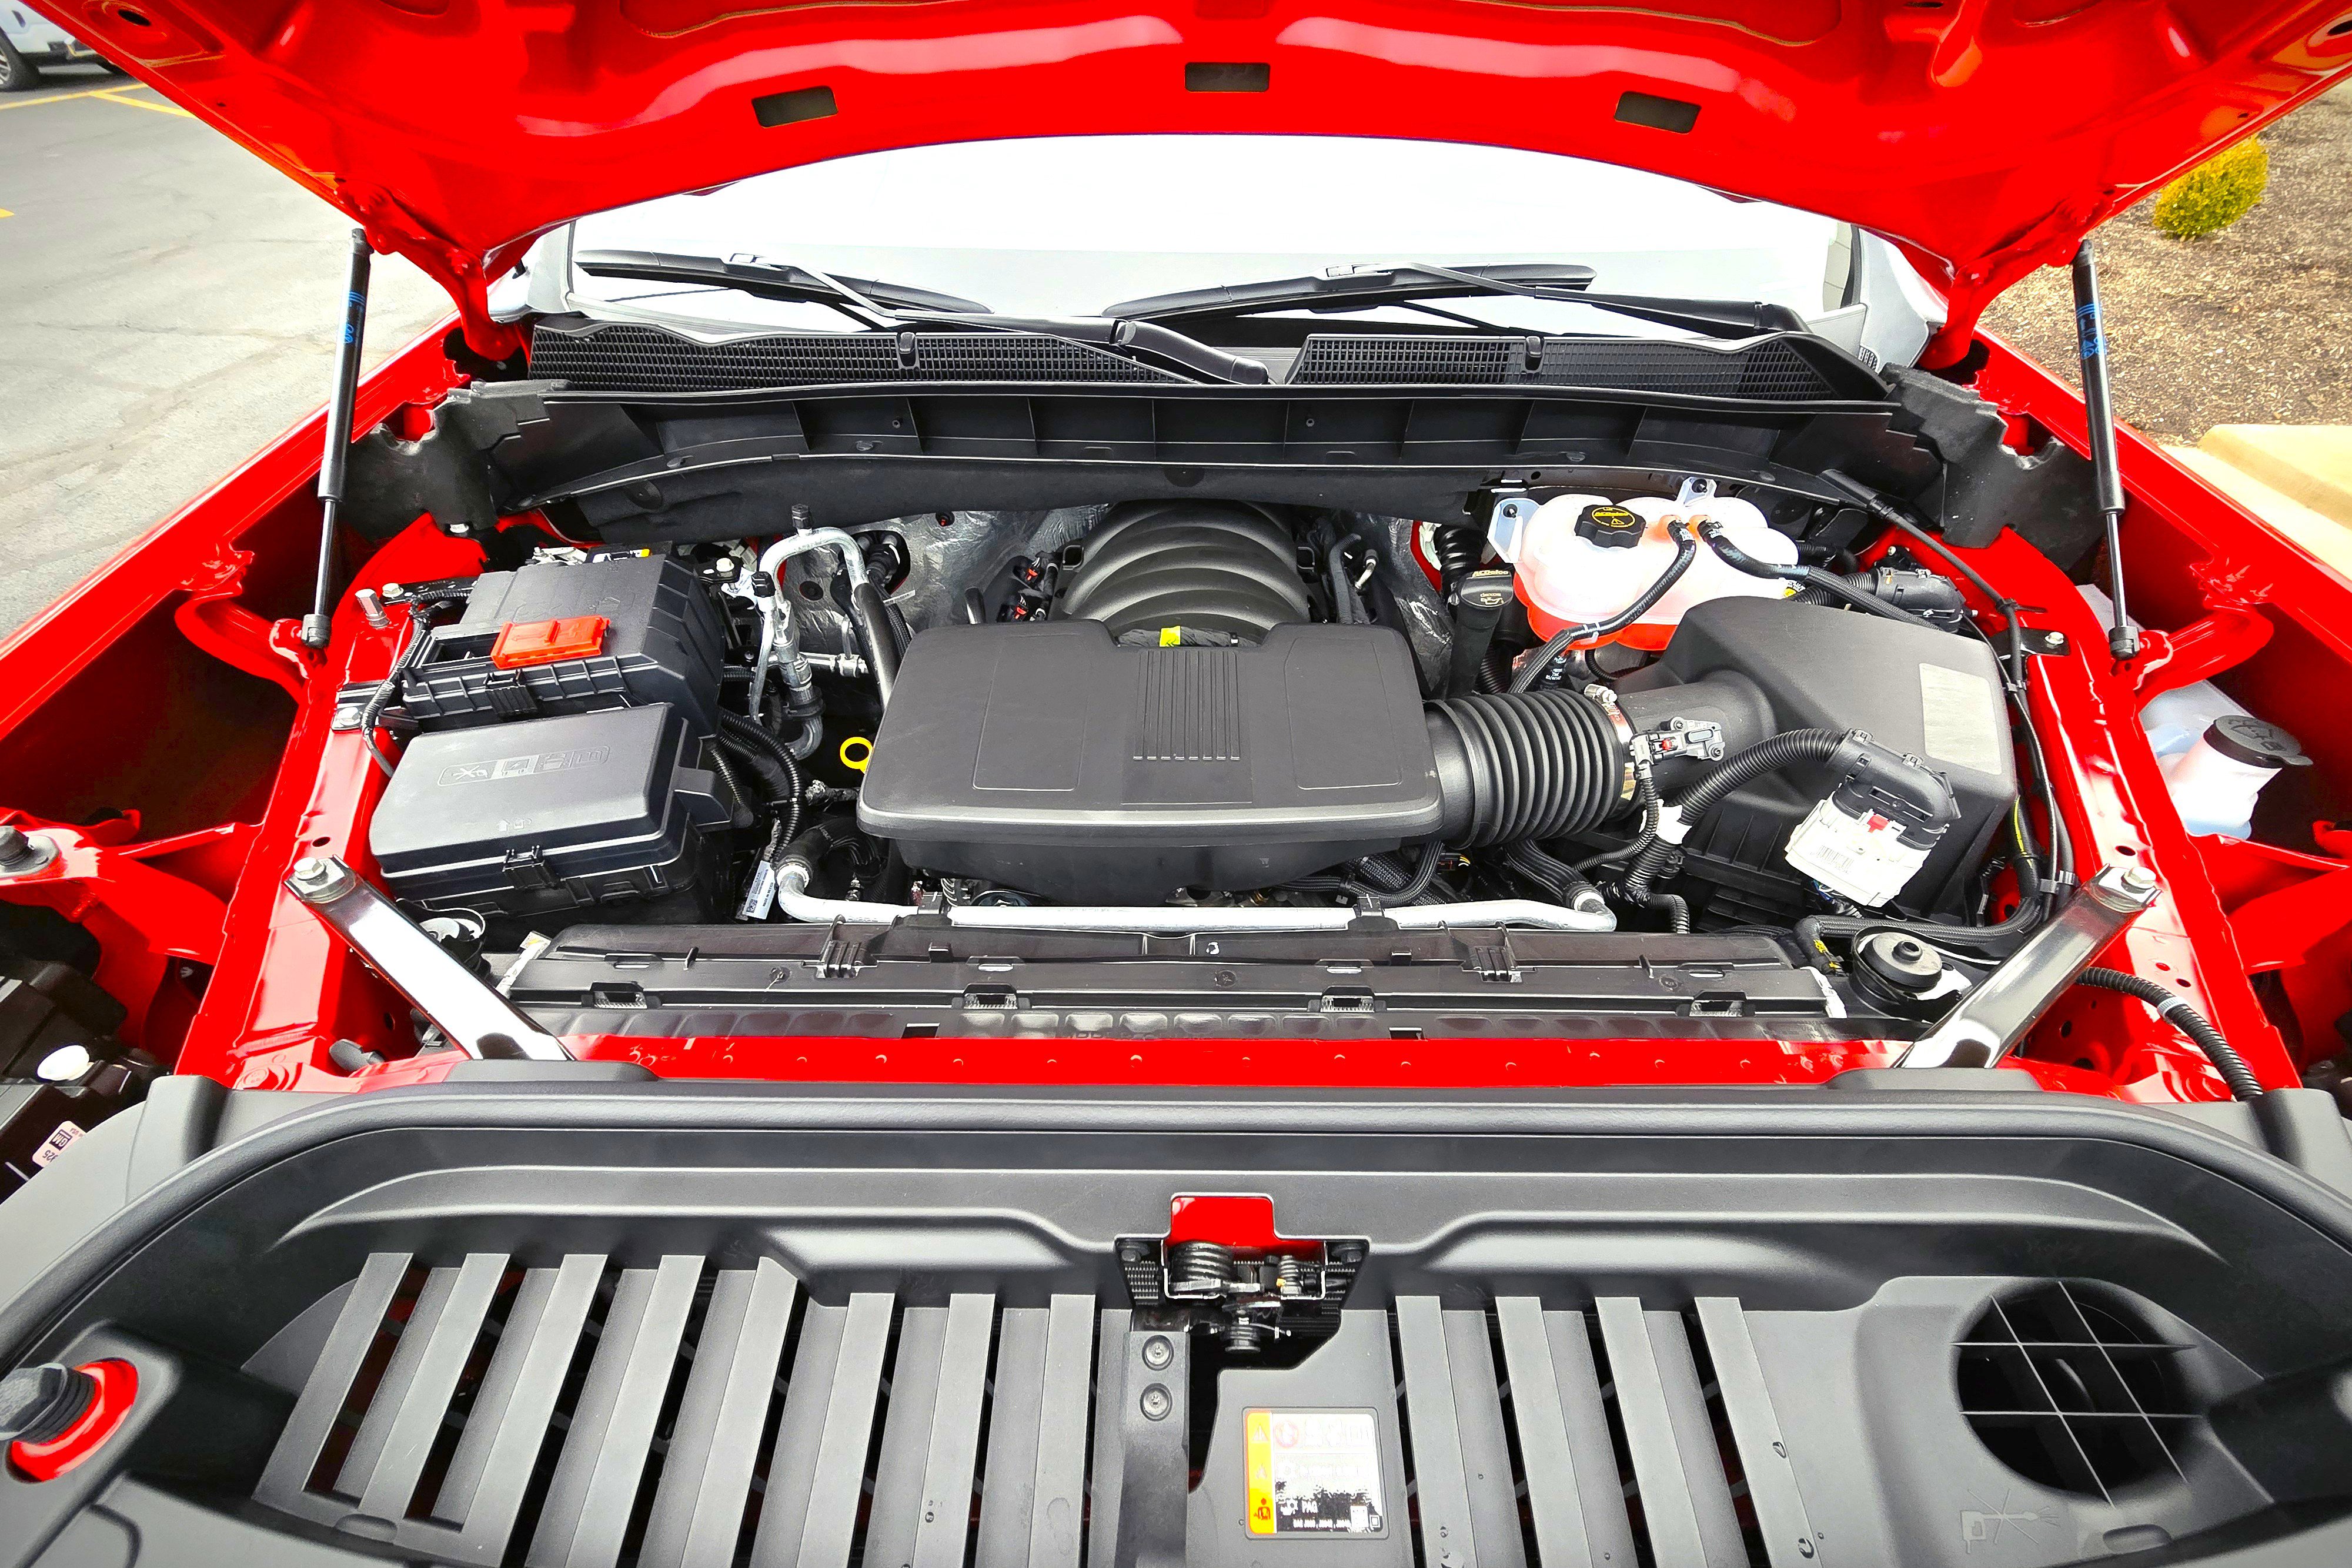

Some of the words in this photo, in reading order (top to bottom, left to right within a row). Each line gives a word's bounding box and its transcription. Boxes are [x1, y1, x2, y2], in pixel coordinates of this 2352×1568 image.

[1472, 570, 1509, 578] ACDelco
[51, 1132, 69, 1148] GM
[1301, 1500, 1318, 1513] PAG
